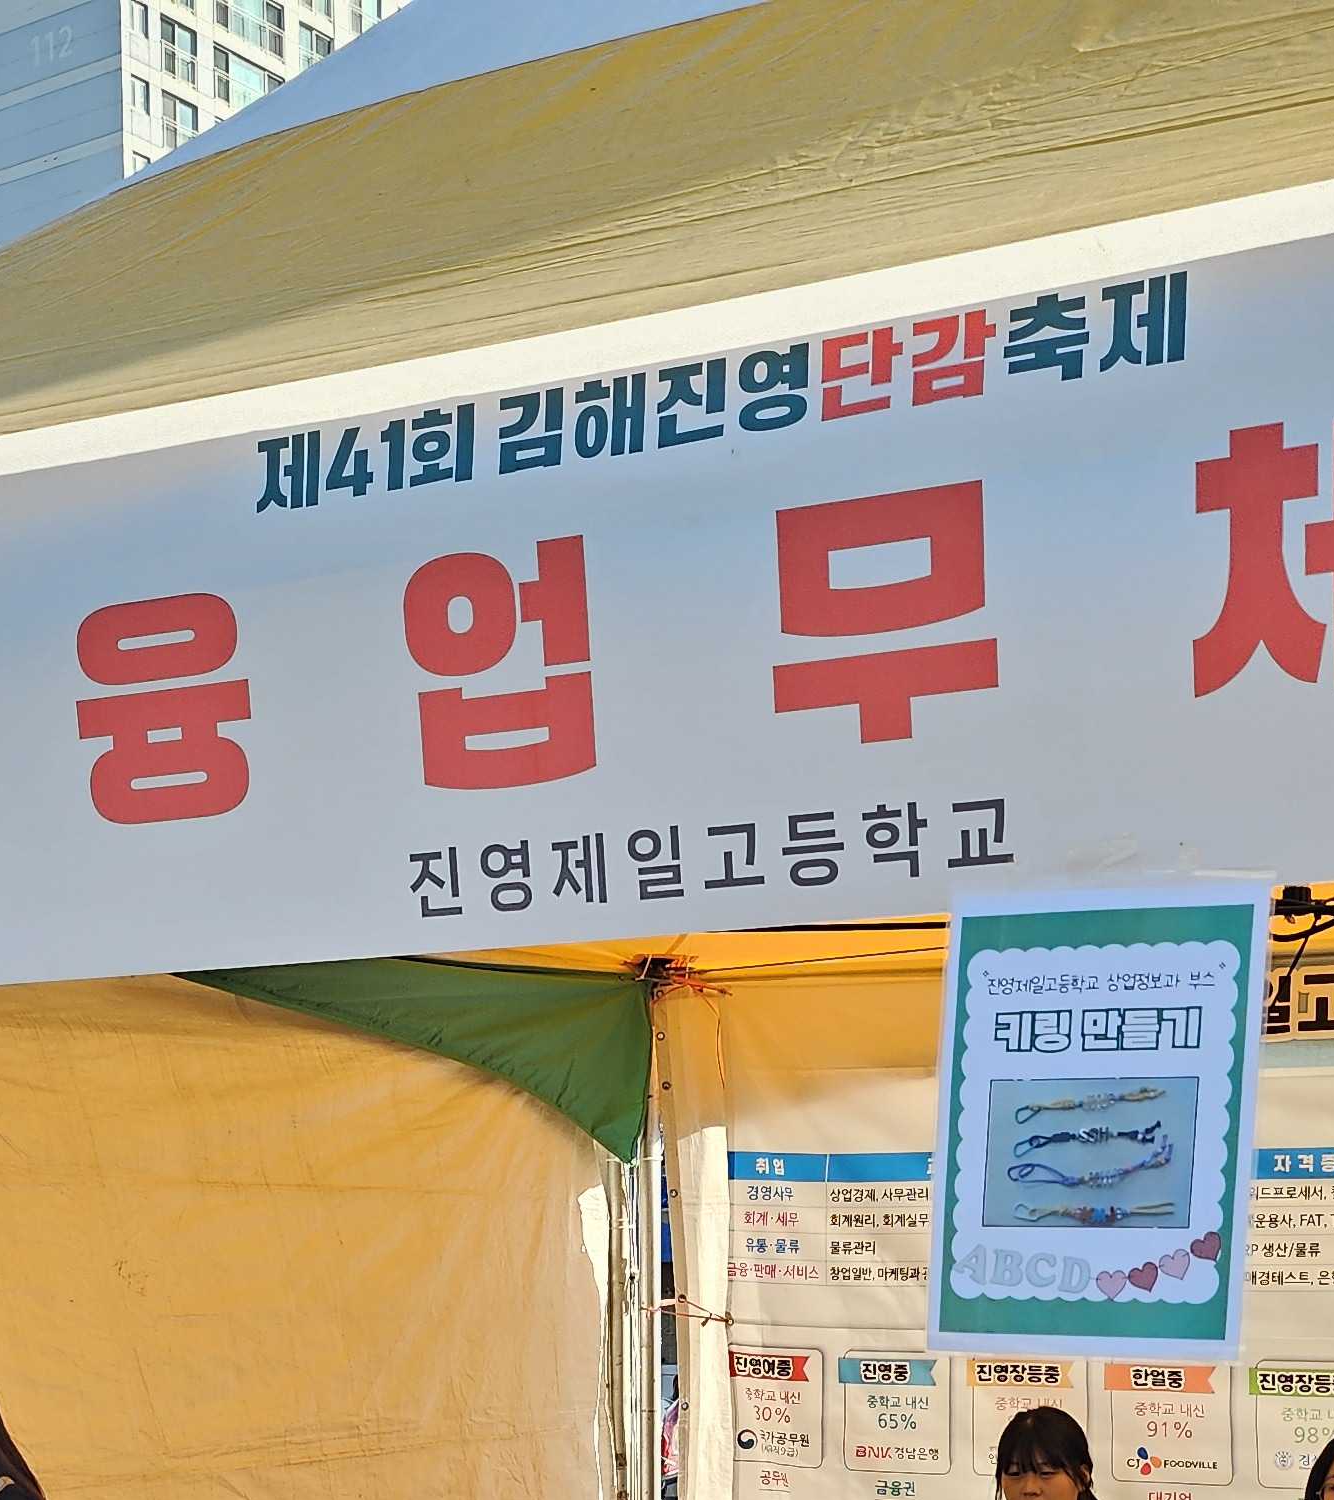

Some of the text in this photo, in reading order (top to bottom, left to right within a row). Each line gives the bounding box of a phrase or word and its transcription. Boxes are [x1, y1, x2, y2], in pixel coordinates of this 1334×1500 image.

[30, 25, 73, 67] 112
[255, 270, 1189, 514] 제41회 김해진영단감축제
[408, 797, 1016, 919] 진영제일고등학교
[987, 971, 1216, 996] 진영제일고등학교 상업정보과 부스
[993, 1005, 1203, 1054] 키링 만들기
[746, 1185, 794, 1202] 경영사무
[829, 1186, 929, 1203] 상업경제, 사무관리
[829, 1213, 930, 1229] 회계원리, 회계실무
[1299, 1214, 1328, 1229] FAT,
[829, 1240, 877, 1256] 물류관리
[1261, 1242, 1321, 1258] 생산/물류
[829, 1266, 876, 1282] 창업일반,
[734, 1355, 793, 1377] 진영여중
[861, 1362, 909, 1382] 진영중
[976, 1364, 1060, 1384] 진영장등중
[1131, 1369, 1184, 1388] 한얼중
[779, 1390, 801, 1405] 내신
[867, 1395, 929, 1410] 중학교 내신
[995, 1396, 1032, 1411] 중학교
[753, 1405, 791, 1424] 30%
[1134, 1401, 1206, 1419] 중학교 내신
[1281, 1407, 1329, 1423] 중학교
[877, 1413, 917, 1430] 65%
[1146, 1421, 1193, 1440] 91%
[855, 1445, 940, 1461] BNK 경남은행
[1126, 1457, 1218, 1471] CJ FOODVILLE
[875, 1479, 916, 1497] 금융권
